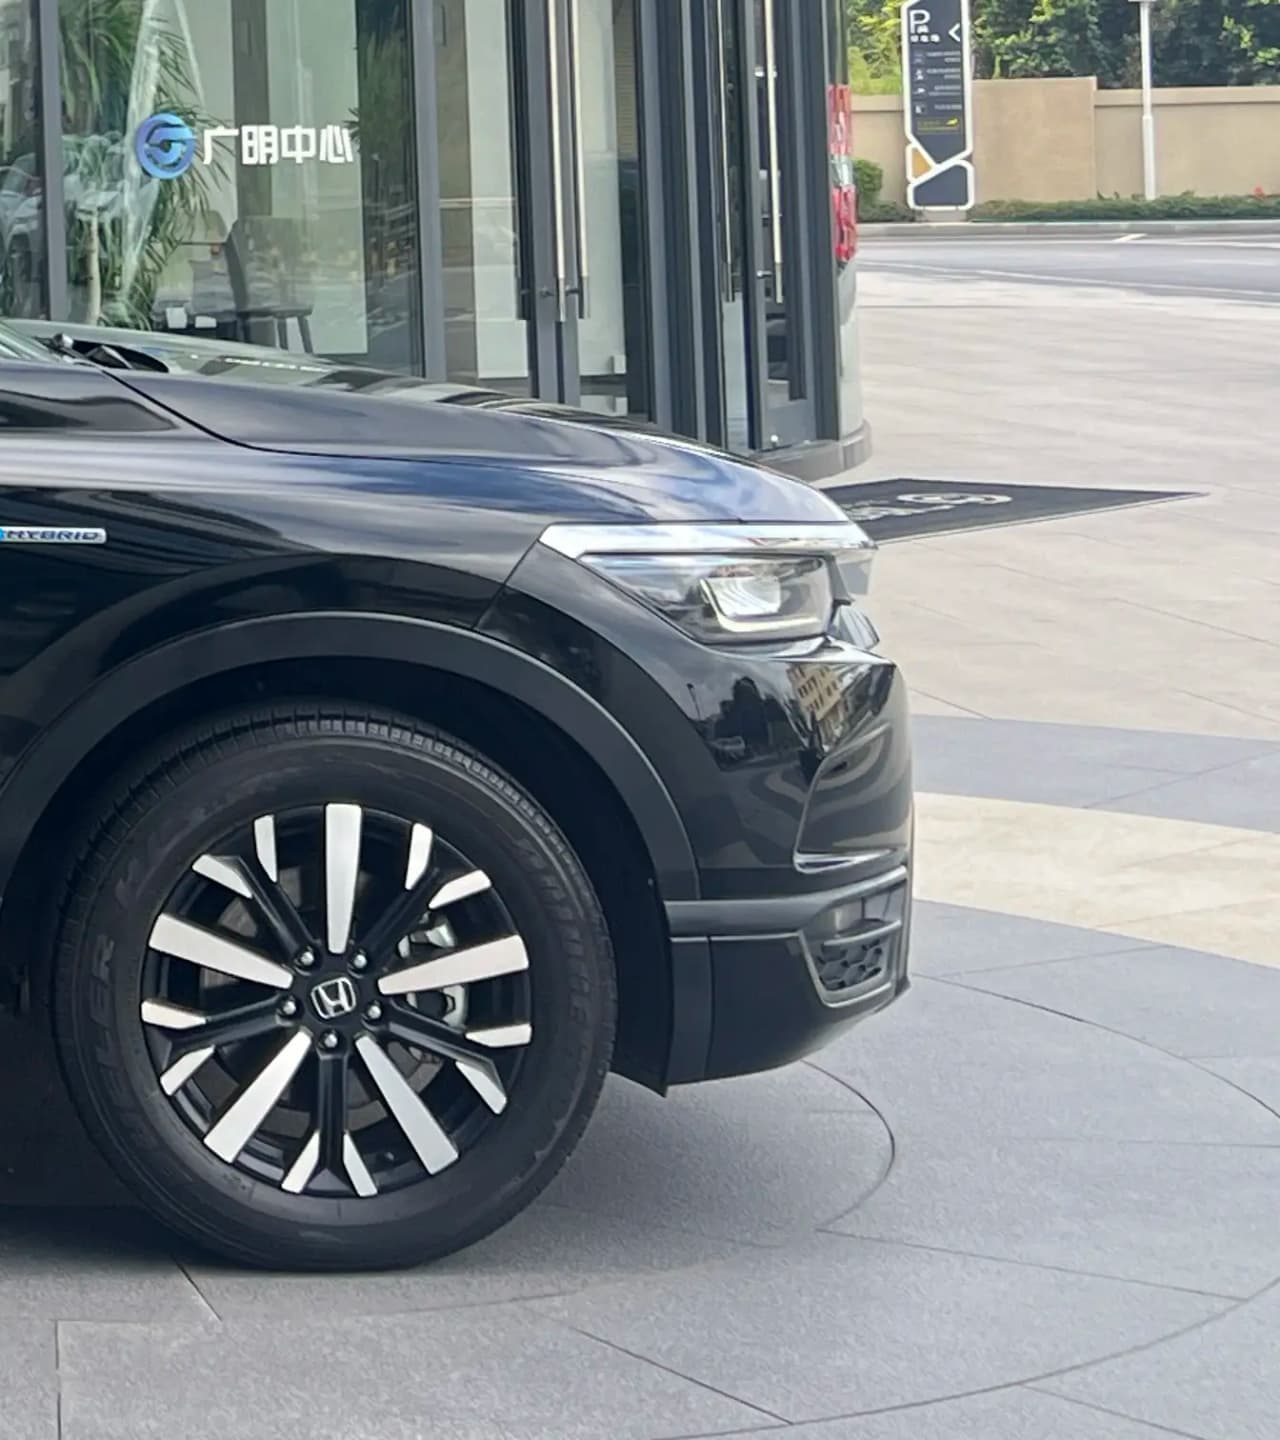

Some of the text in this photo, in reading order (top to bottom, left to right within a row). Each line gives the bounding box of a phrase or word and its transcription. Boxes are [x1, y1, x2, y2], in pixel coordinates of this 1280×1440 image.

[909, 10, 931, 34] P
[202, 124, 354, 166] 广明中心
[6, 529, 99, 541] HYBRID
